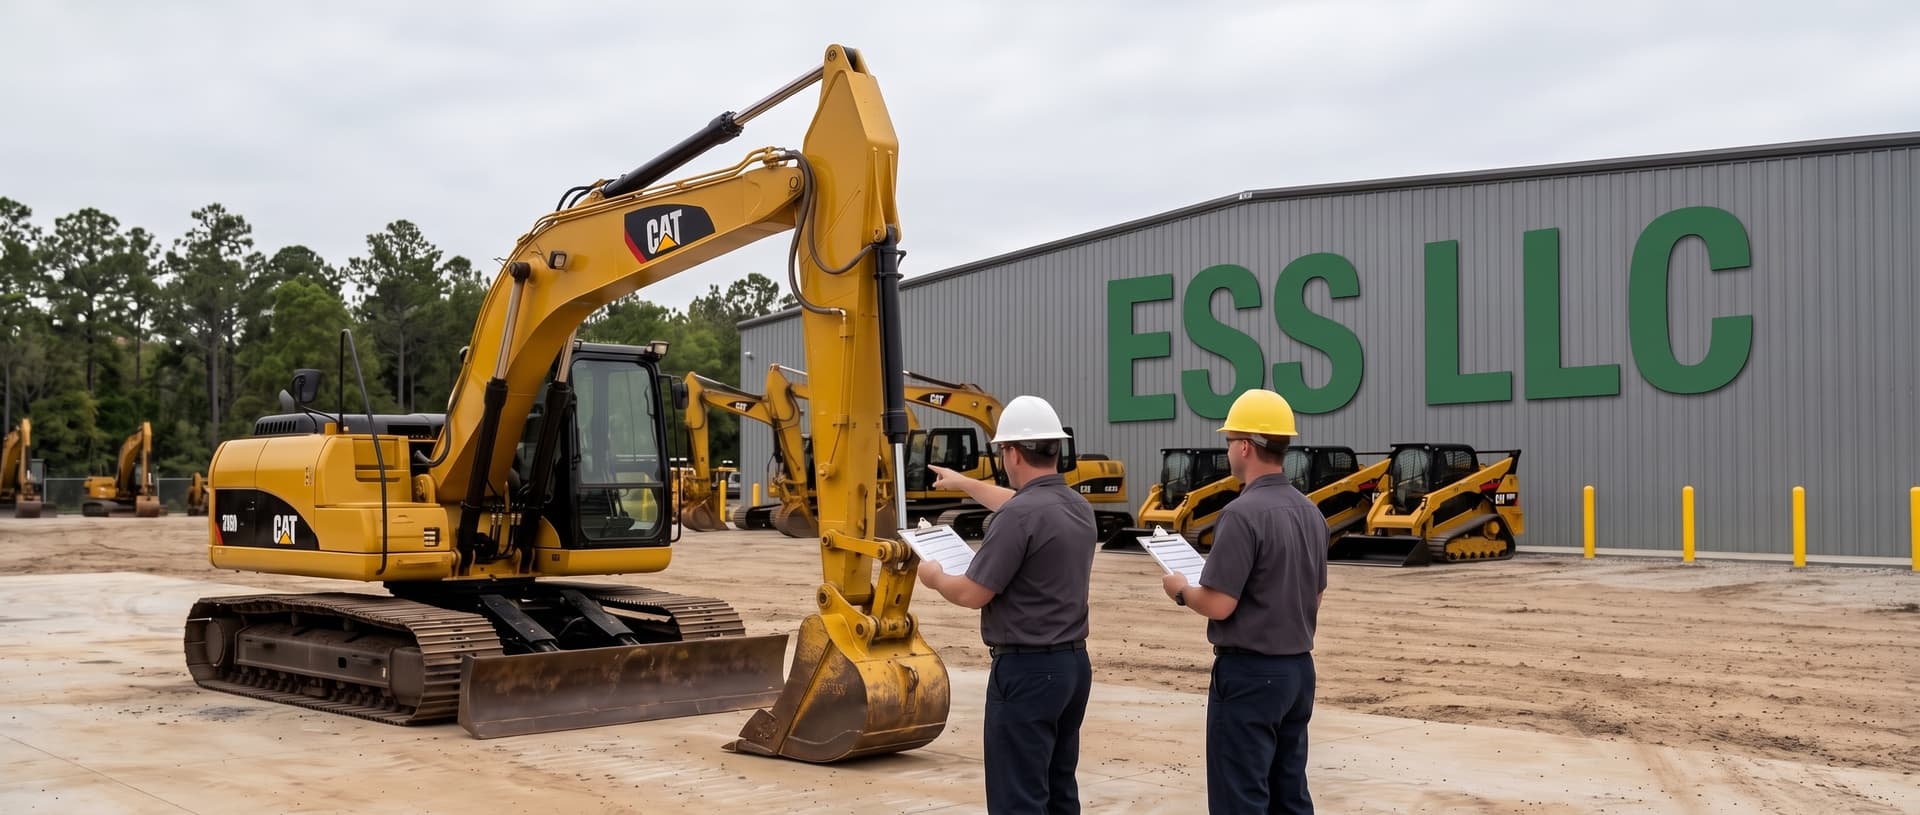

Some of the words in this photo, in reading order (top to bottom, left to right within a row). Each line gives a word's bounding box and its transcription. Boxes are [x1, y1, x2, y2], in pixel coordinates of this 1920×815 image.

[646, 209, 682, 254] CAT
[1107, 252, 1364, 422] ESS
[1425, 206, 1752, 405] LLC
[273, 514, 298, 545] CAT
